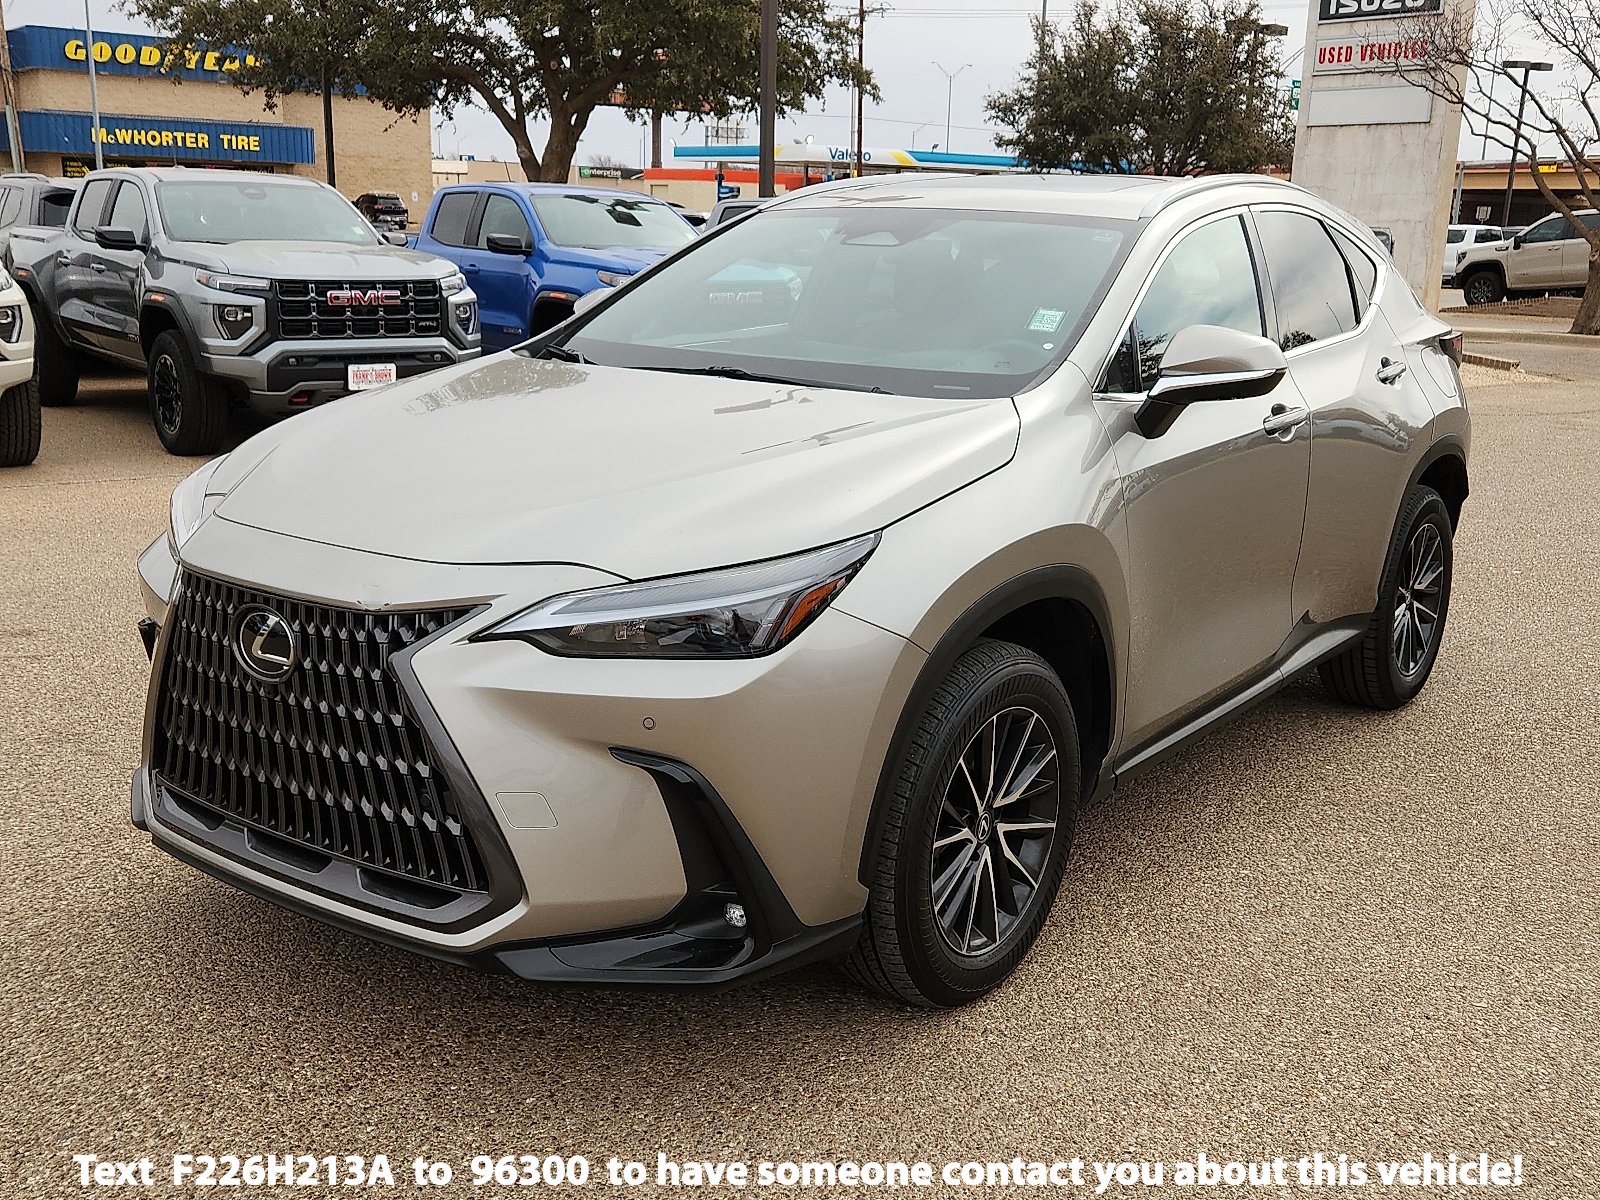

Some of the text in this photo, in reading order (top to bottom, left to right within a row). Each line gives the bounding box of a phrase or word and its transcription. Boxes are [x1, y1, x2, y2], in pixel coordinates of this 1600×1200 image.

[1329, 0, 1425, 15] ISU
[1319, 39, 1430, 64] USED VEHICLES
[91, 127, 261, 151] McWHORTER TIRE
[828, 146, 872, 162] Valeo
[581, 168, 622, 177] enterprise
[327, 290, 401, 306] GMC
